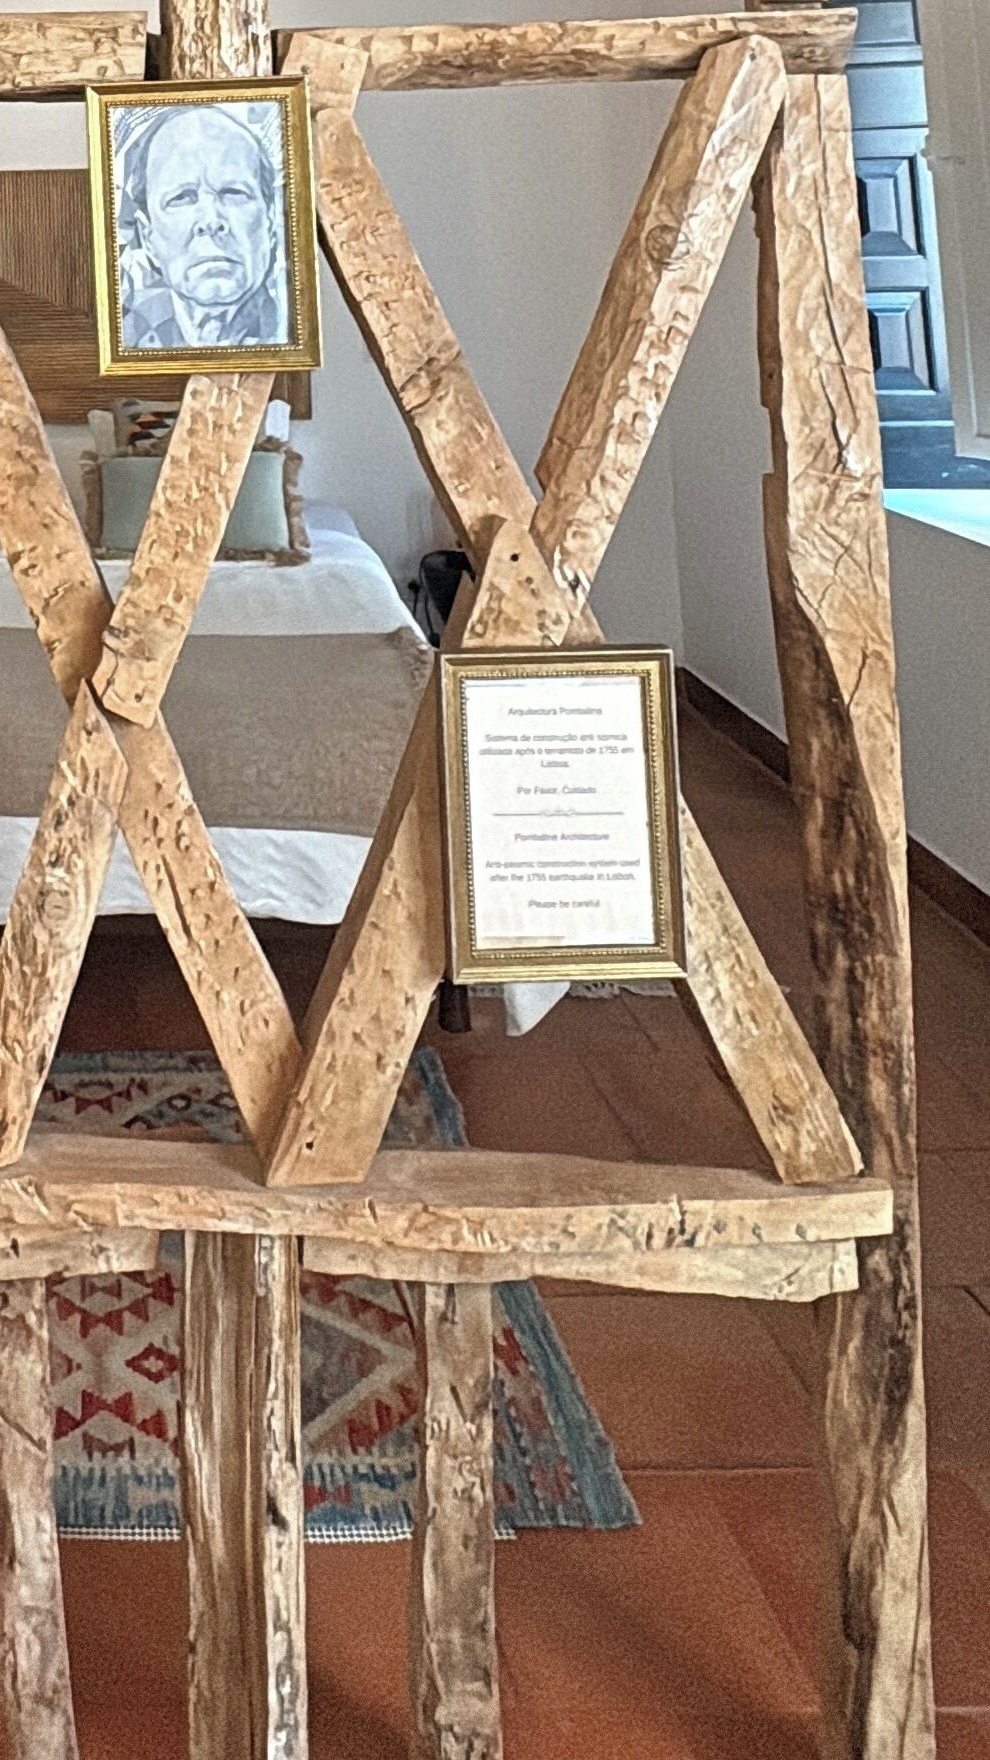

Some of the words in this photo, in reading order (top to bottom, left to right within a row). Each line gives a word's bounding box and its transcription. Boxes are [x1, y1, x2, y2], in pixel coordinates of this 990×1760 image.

[520, 734, 531, 742] de
[585, 746, 596, 754] de
[598, 746, 619, 754] 1755
[517, 786, 531, 794] Por
[560, 833, 610, 841] Architecture
[490, 874, 509, 882] after
[511, 873, 524, 882] the
[526, 873, 547, 882] 1755
[548, 873, 595, 883] earthquake
[597, 873, 605, 881] in
[528, 900, 557, 909] Please
[559, 899, 570, 908] be
